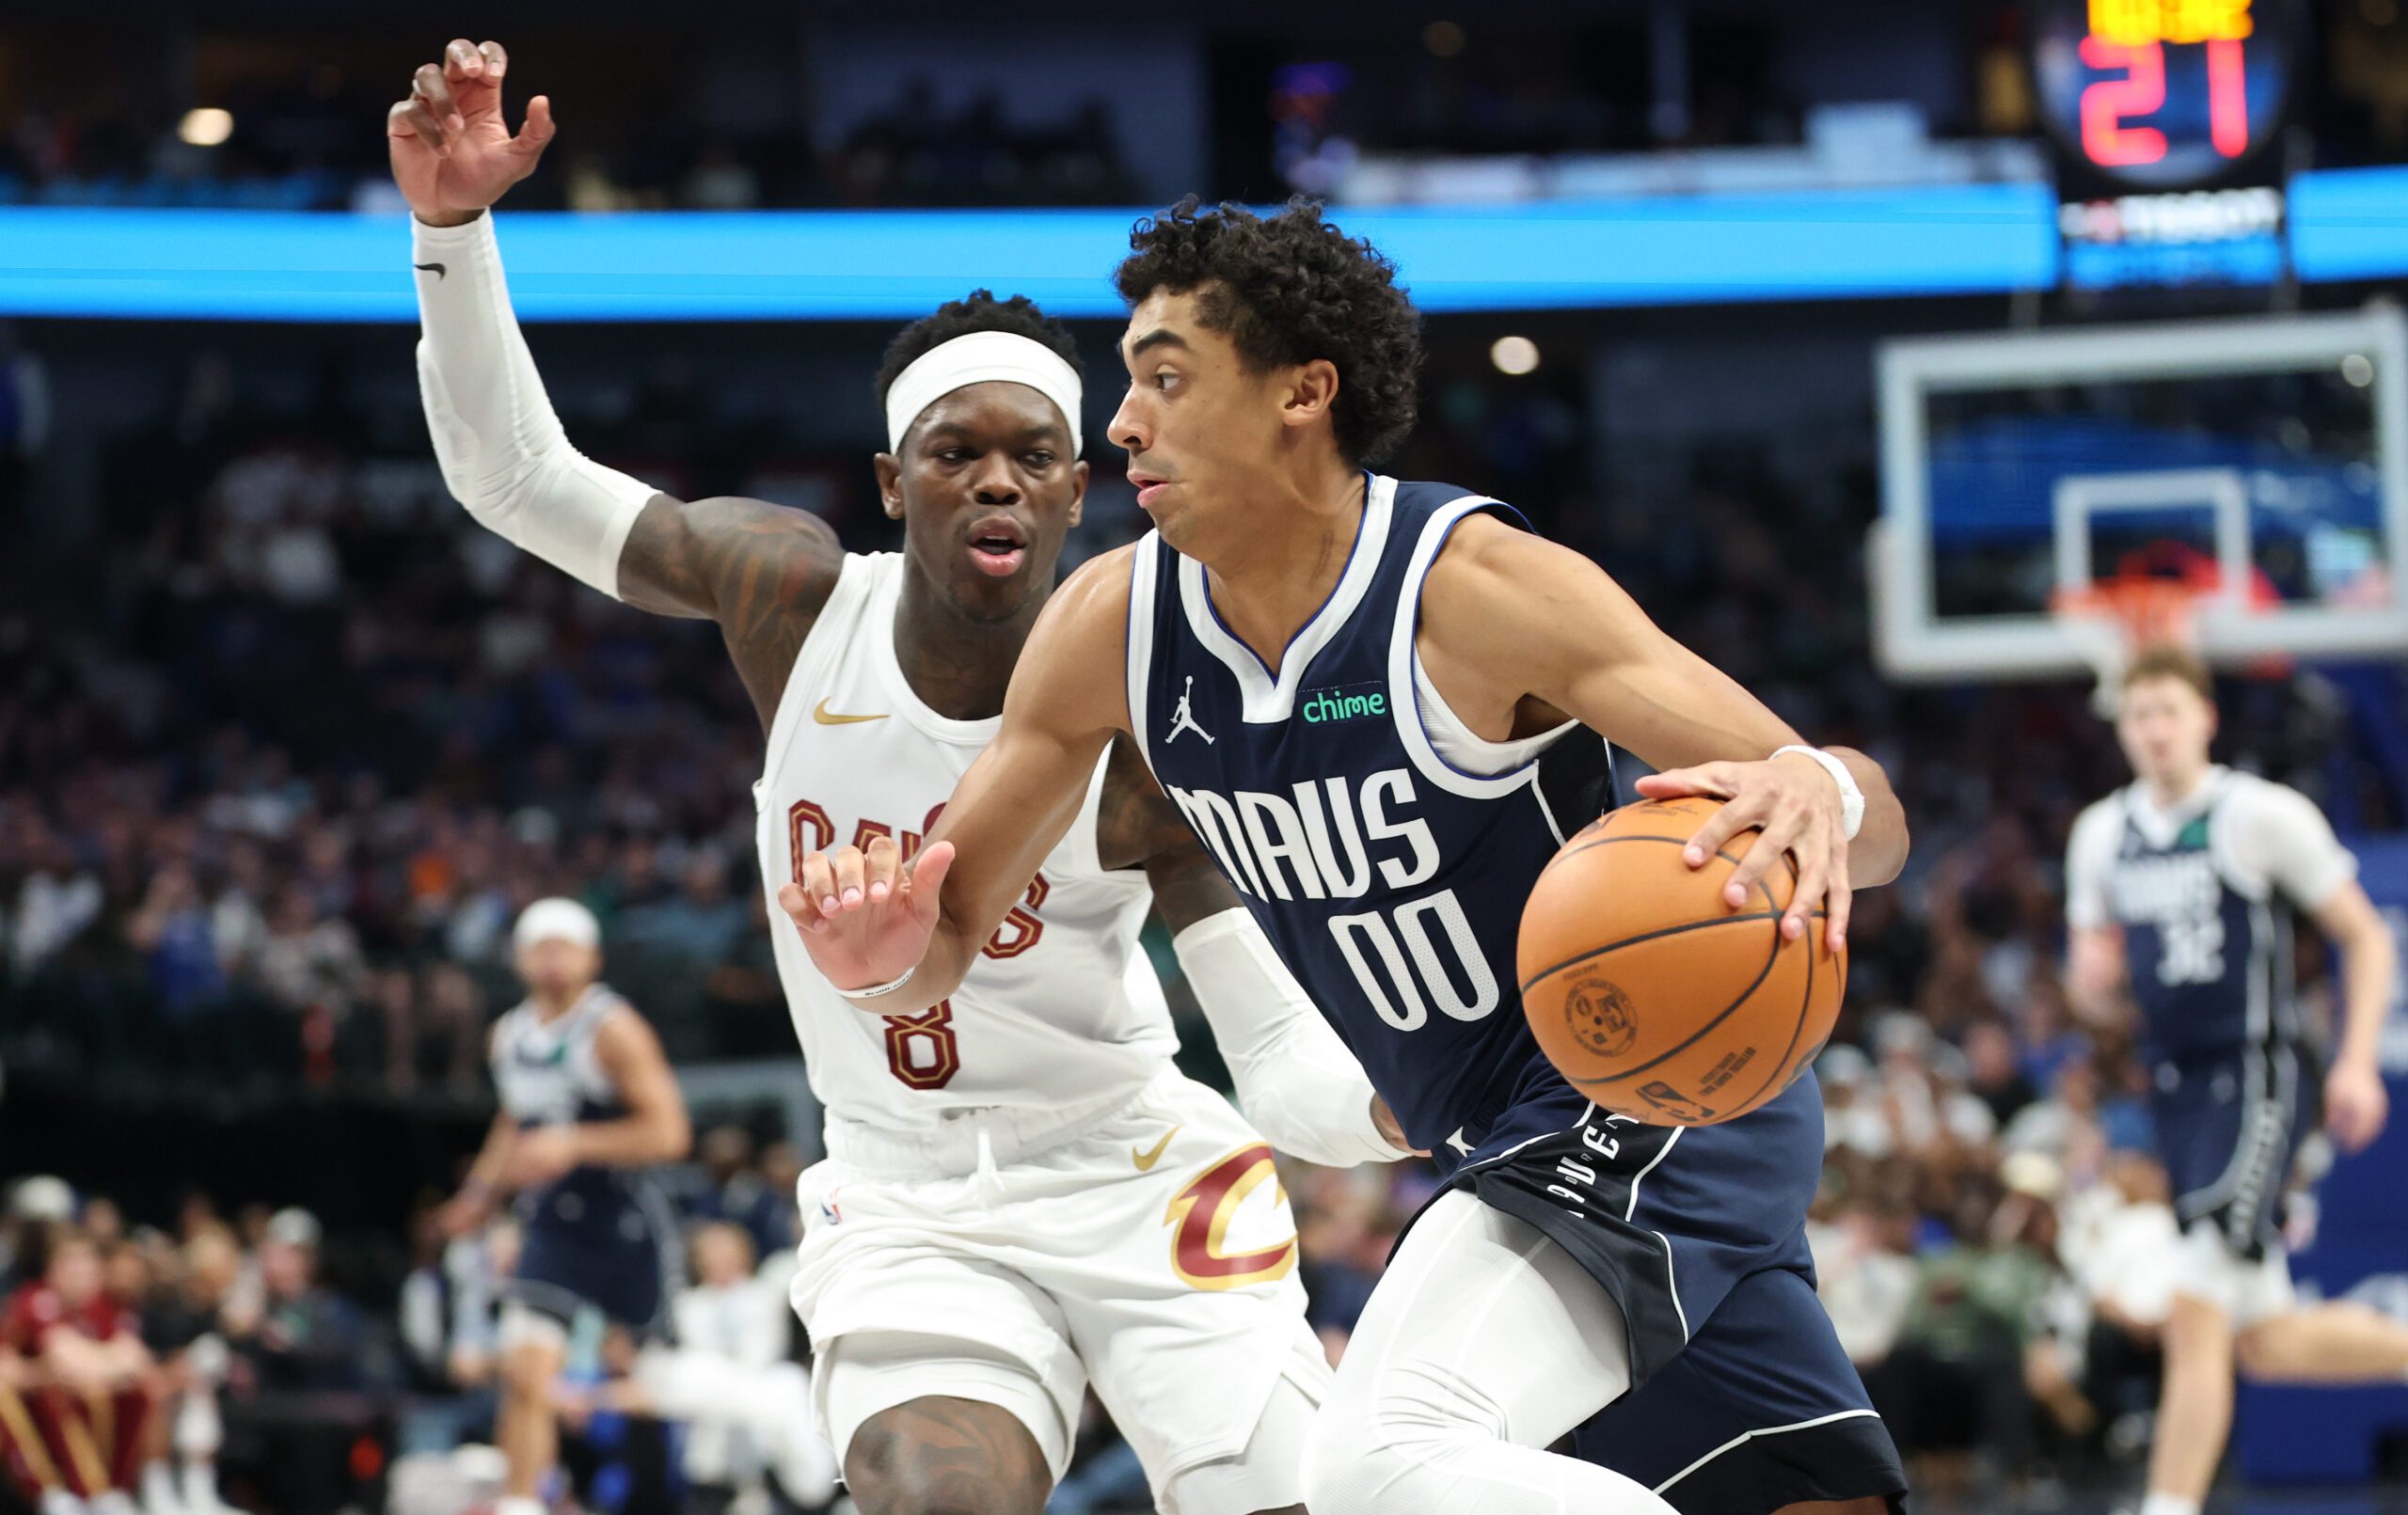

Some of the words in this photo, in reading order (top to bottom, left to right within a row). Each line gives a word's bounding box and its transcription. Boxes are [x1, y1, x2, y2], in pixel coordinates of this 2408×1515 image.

[2078, 34, 2249, 166] 21
[1304, 690, 1386, 723] chime
[1165, 768, 1440, 903] MAVS
[1327, 889, 1500, 1033] 00
[882, 999, 960, 1090] 8
